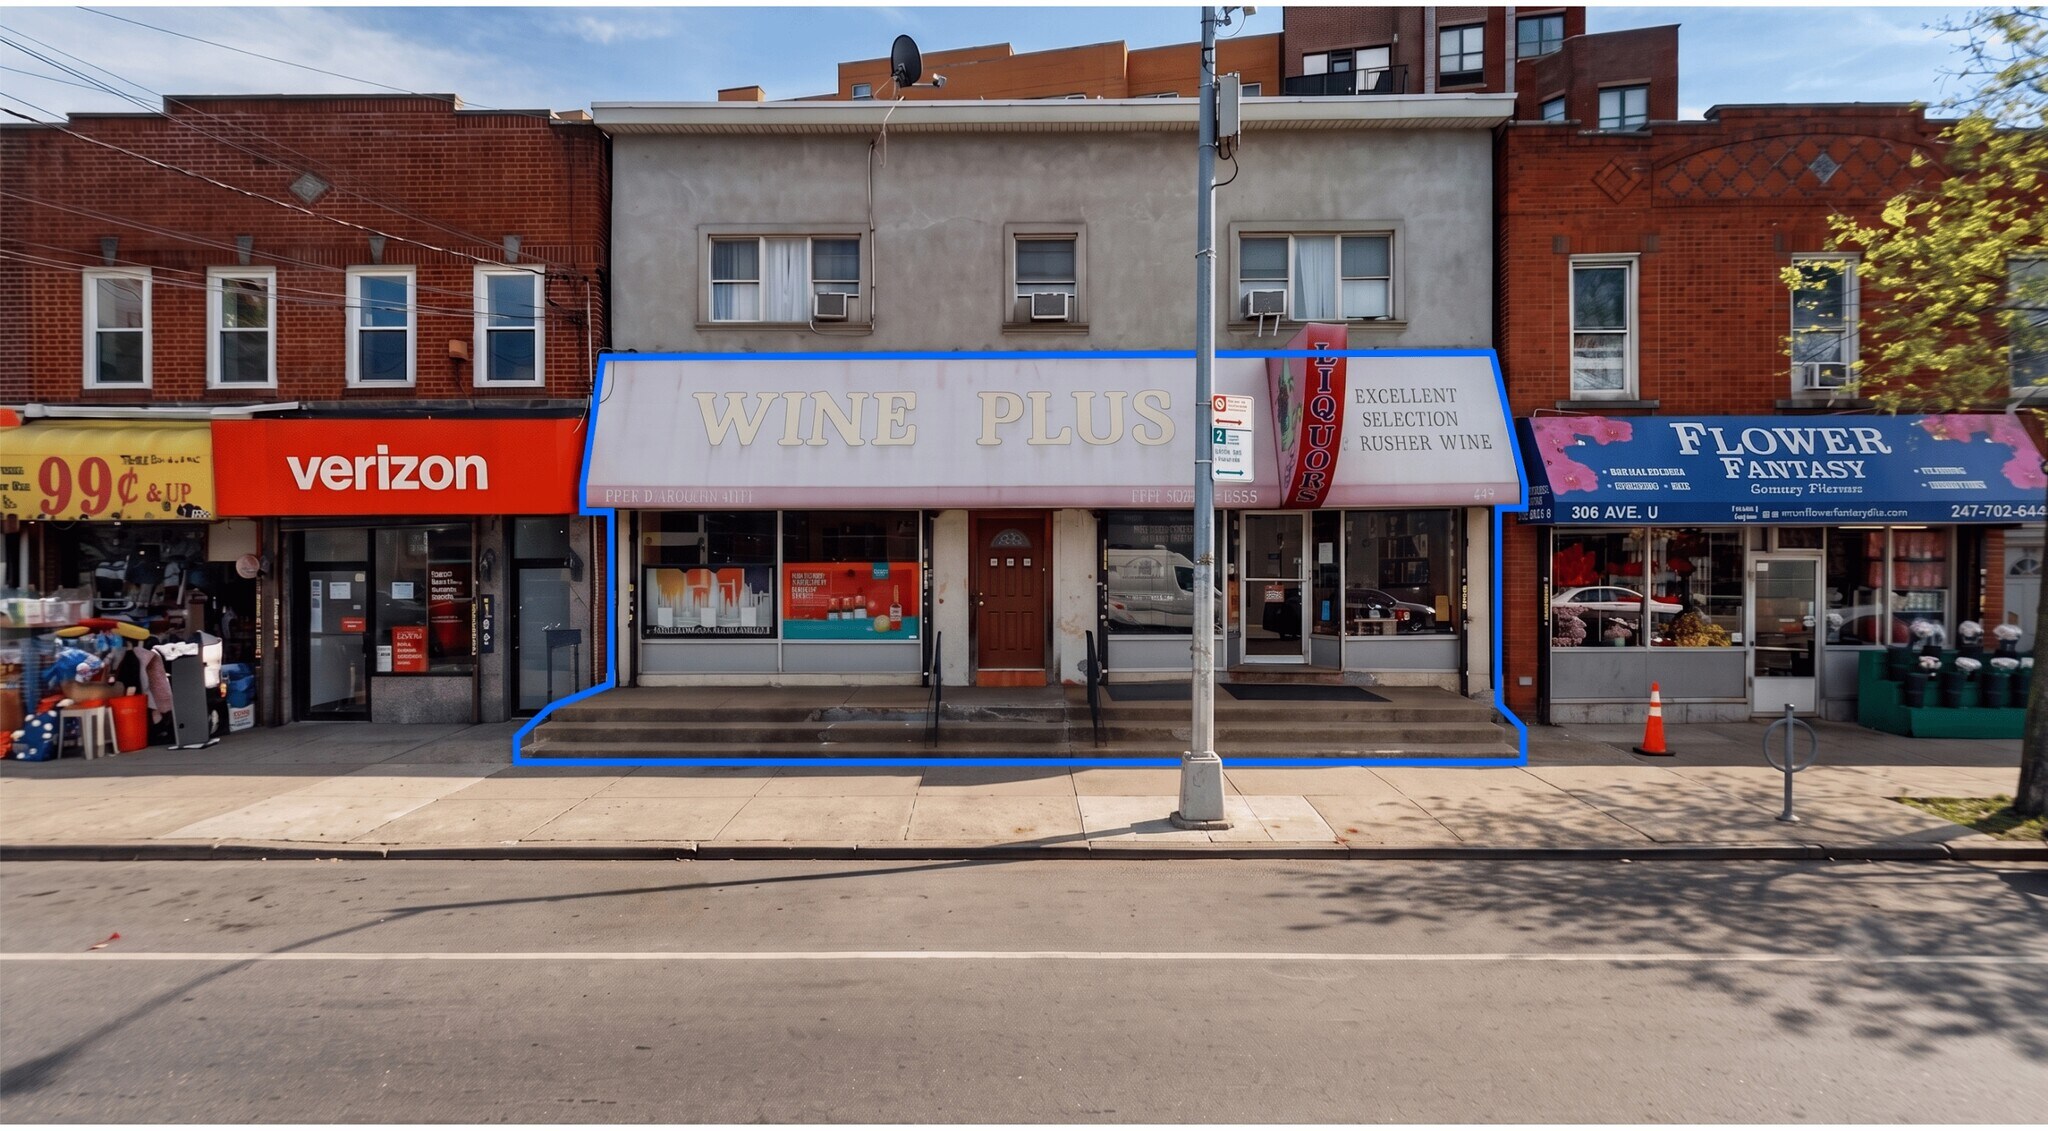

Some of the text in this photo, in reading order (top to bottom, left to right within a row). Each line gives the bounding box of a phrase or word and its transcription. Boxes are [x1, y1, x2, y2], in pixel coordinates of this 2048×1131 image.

[1355, 388, 1457, 404] EXCELLENT
[692, 390, 1176, 446] WINE PLUS
[1296, 342, 1338, 502] LIQUORS
[1362, 411, 1459, 427] SELECTION
[1216, 430, 1223, 442] 2
[1360, 434, 1493, 451] RUSHER WINE
[1669, 422, 1892, 455] FLOWER
[286, 444, 488, 490] verizon
[1719, 457, 1866, 479] FANTASY
[146, 483, 162, 502] &
[166, 483, 191, 503] UP
[1571, 506, 1659, 519] 306 AVE. U
